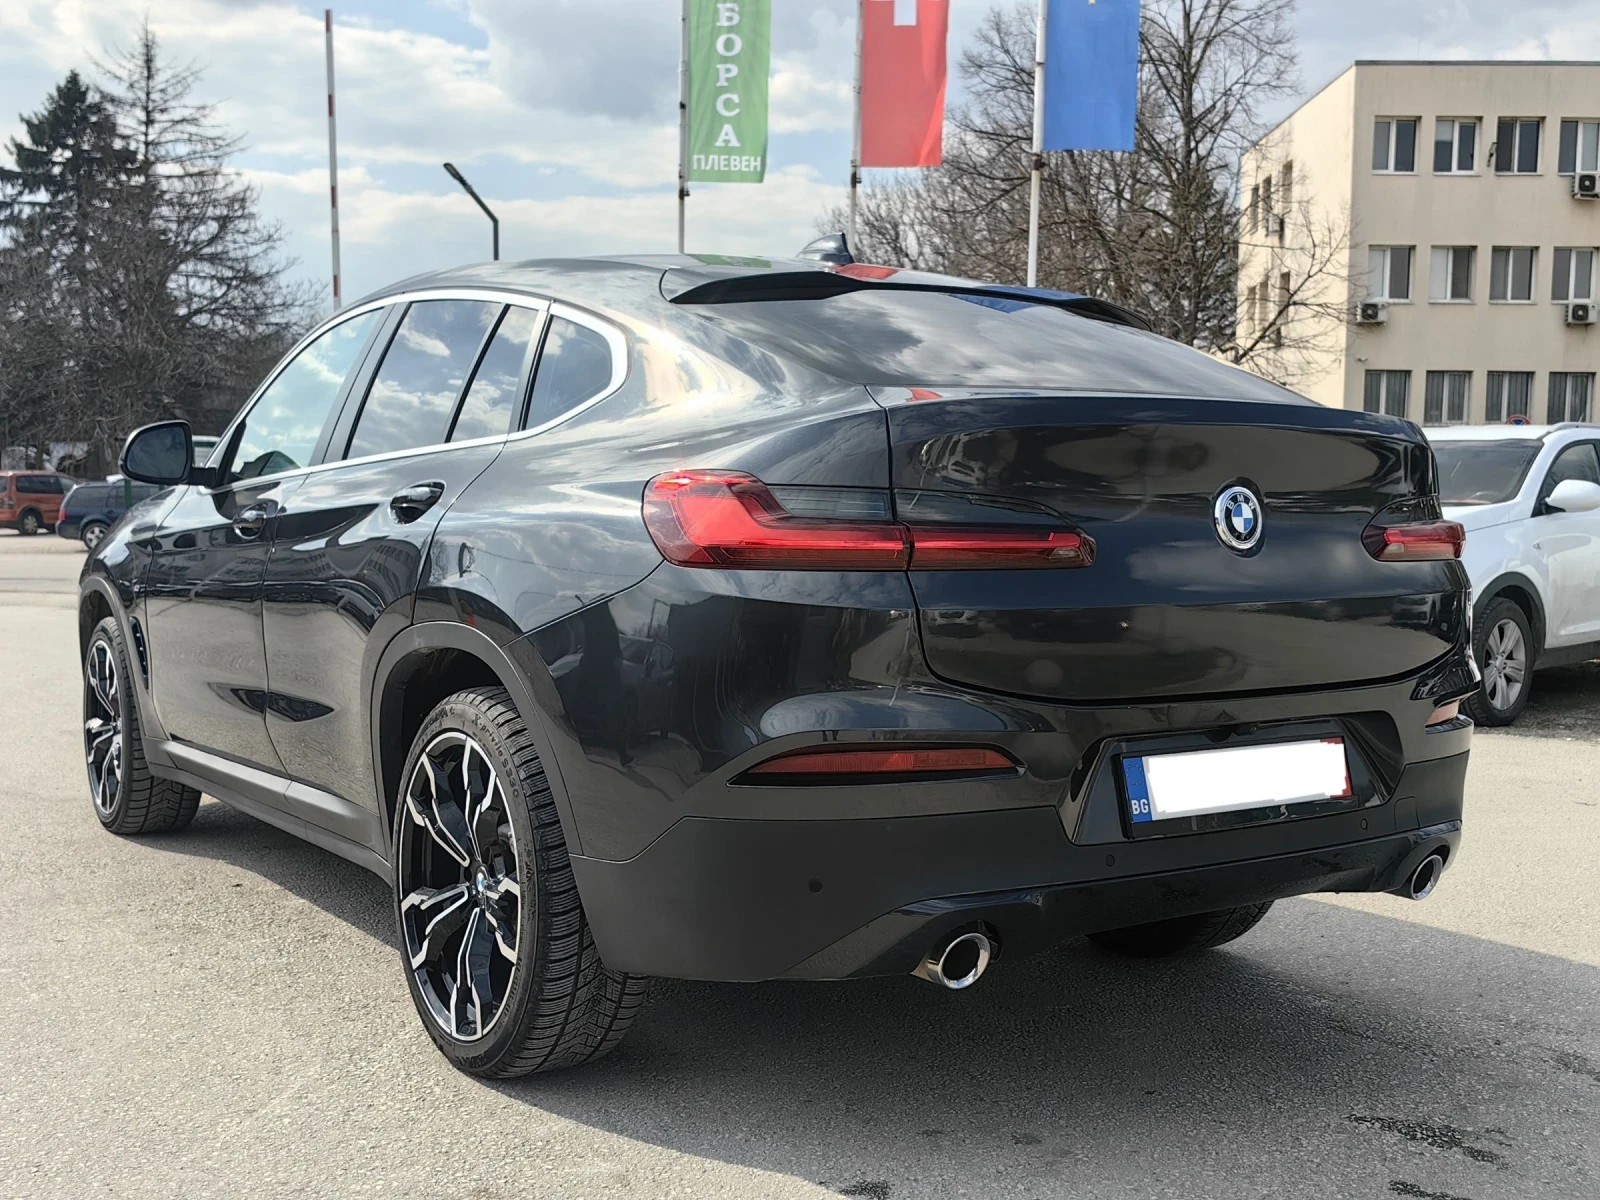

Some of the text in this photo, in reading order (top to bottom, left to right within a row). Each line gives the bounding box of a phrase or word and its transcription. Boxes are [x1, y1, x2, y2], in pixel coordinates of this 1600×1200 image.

[715, 3, 742, 147] БОРСА
[693, 154, 761, 171] ПЛЕВЕН
[1226, 494, 1255, 510] BMW
[1131, 799, 1149, 815] BG
